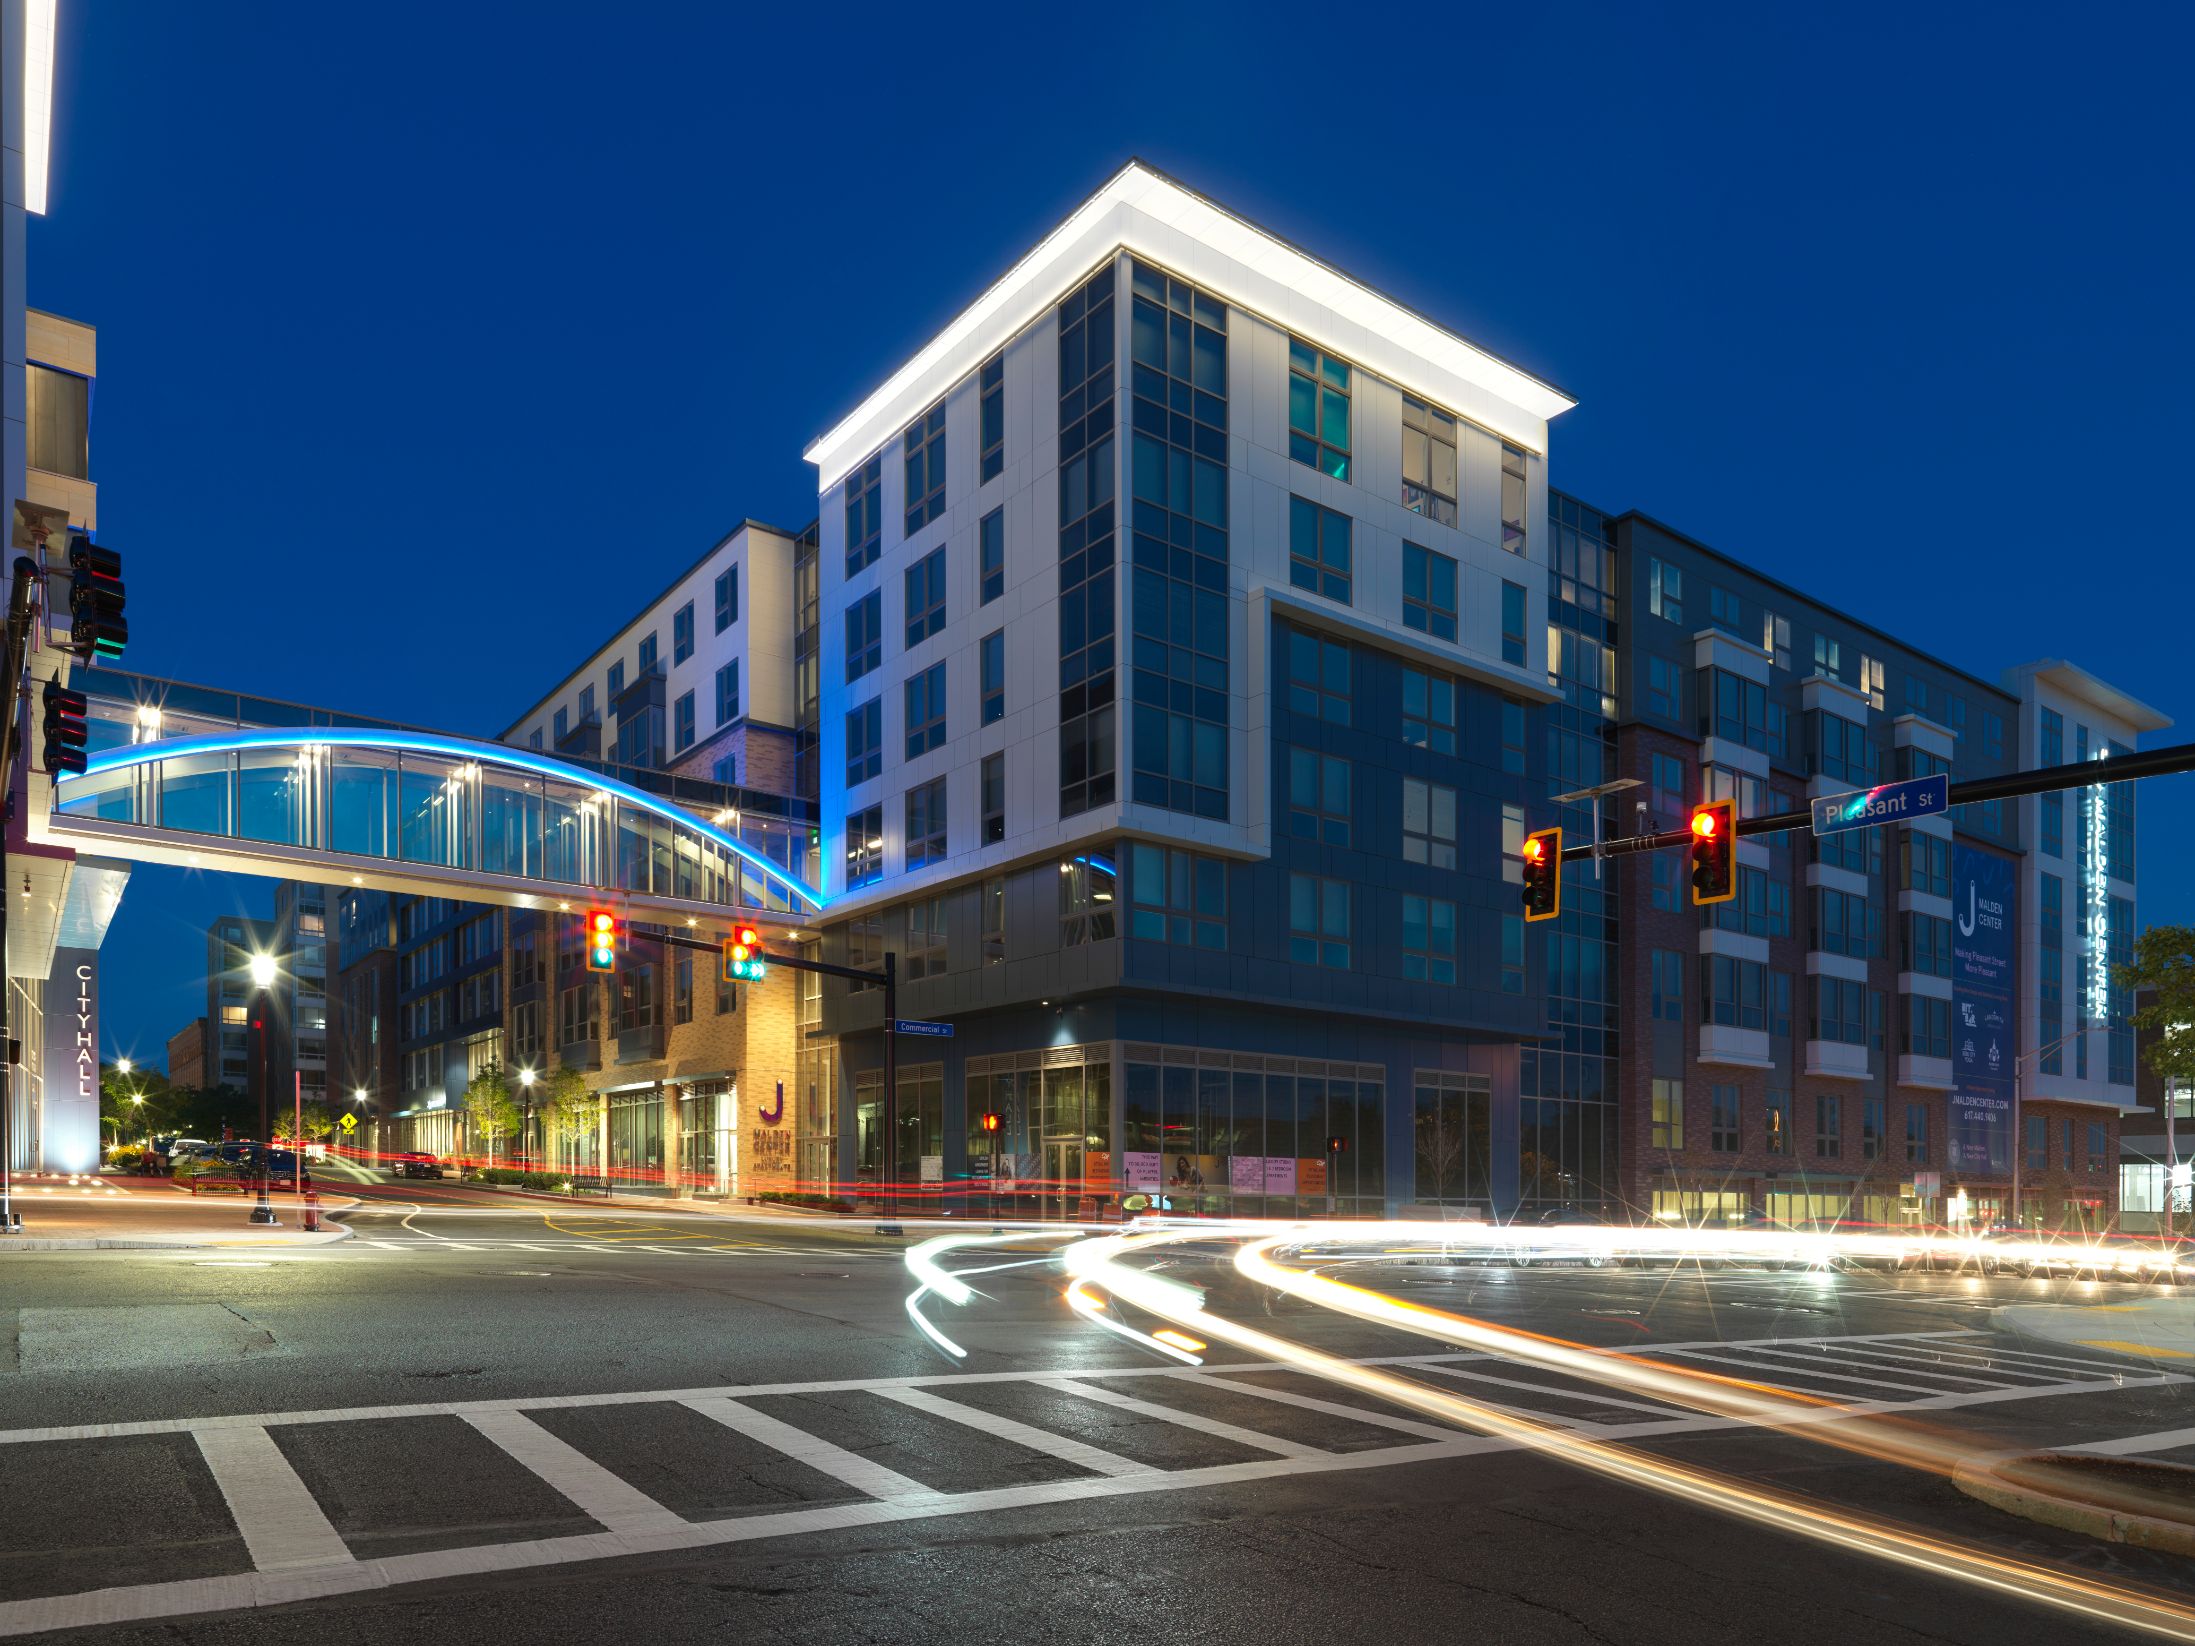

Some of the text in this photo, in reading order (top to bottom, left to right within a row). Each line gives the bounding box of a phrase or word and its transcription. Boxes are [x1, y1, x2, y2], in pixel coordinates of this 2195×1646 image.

[1825, 792, 1933, 824] Pleasant St
[2095, 796, 2109, 906] MALDEN
[1959, 880, 1976, 937] J
[1979, 897, 2003, 916] MALDEN
[1979, 914, 2003, 930] CENTER
[2094, 914, 2109, 1020] CENTER
[76, 965, 93, 1096] CITY HALL
[901, 1022, 940, 1033] Commercial
[759, 1079, 783, 1123] J
